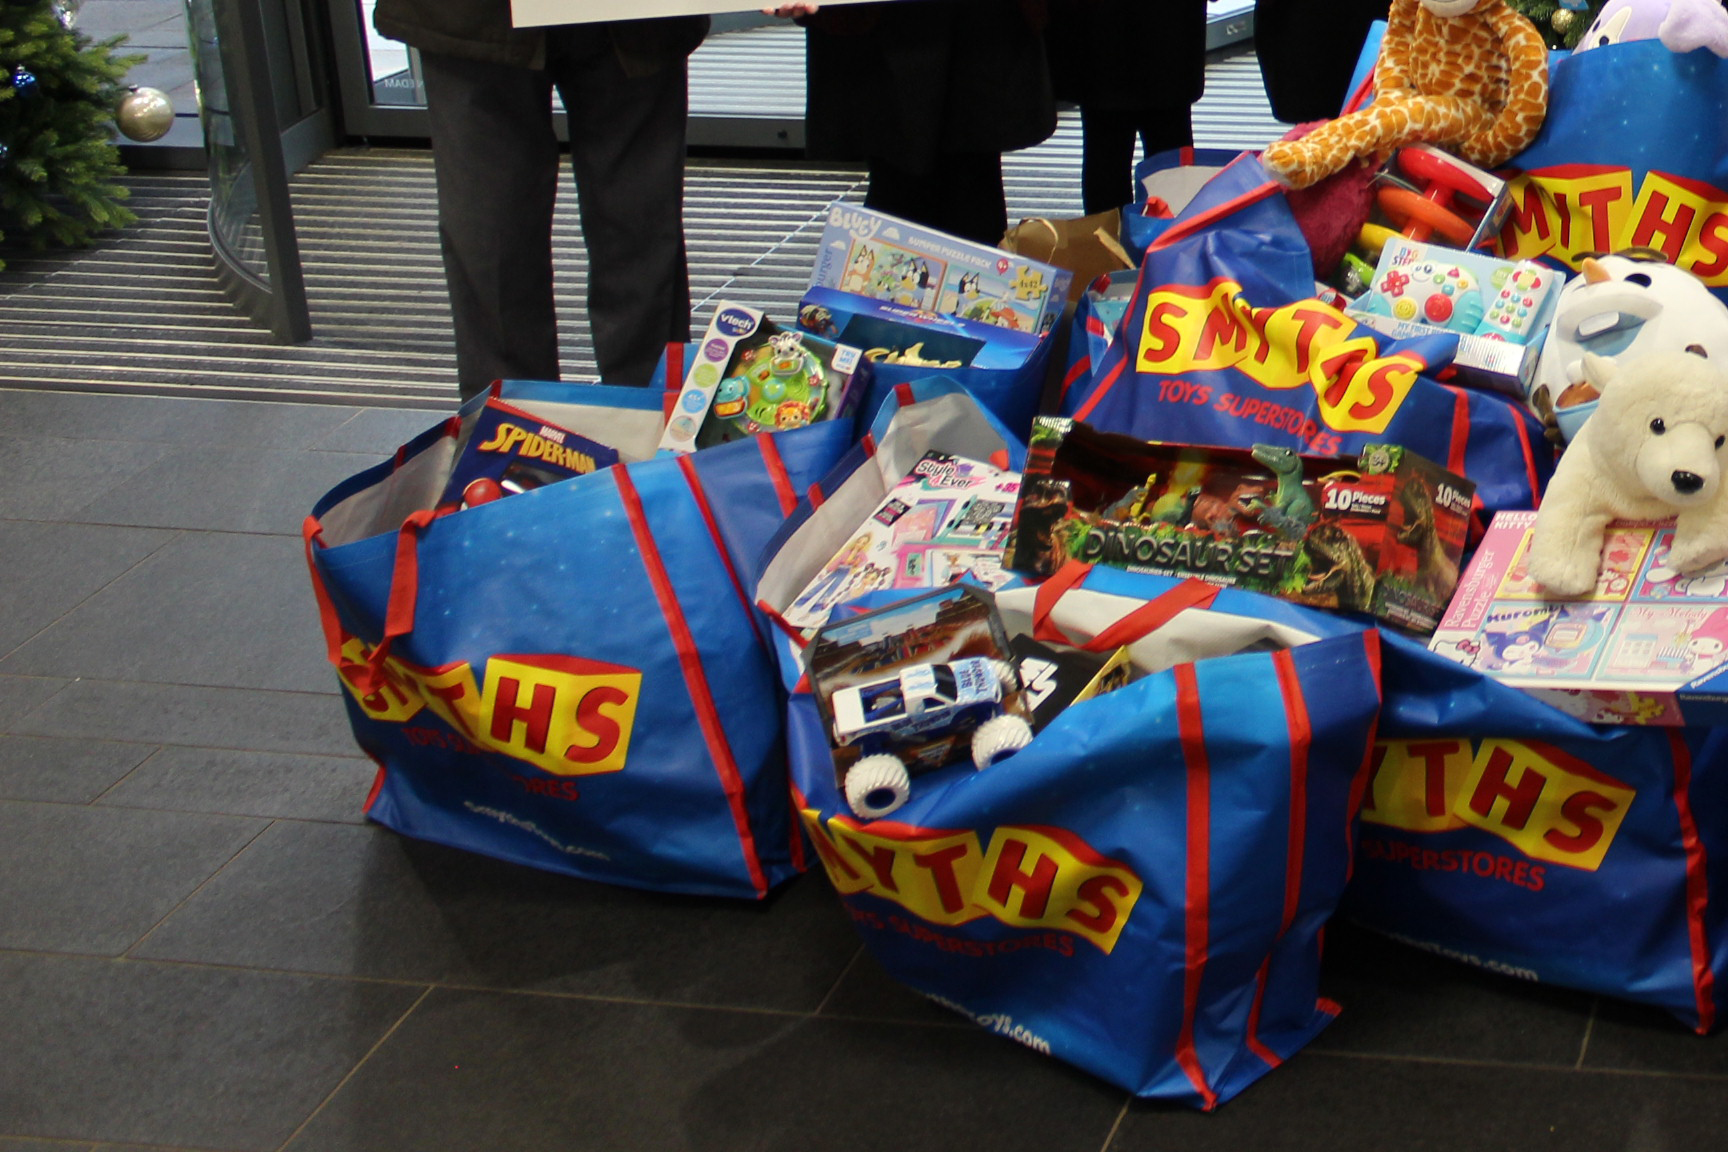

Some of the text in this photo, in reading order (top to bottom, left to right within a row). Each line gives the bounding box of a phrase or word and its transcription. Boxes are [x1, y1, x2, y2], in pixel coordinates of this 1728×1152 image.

[908, 236, 992, 270] BUMPER PUZZLE PACK
[1158, 381, 1345, 457] TOYS SUPERSTORES
[539, 425, 566, 444] MARVEL
[478, 422, 597, 475] SPIDER-MAN
[917, 462, 955, 480] Style
[1325, 488, 1352, 511] 10
[1352, 491, 1386, 506] Pieces
[1435, 483, 1471, 508] 10 Pieces
[1494, 520, 1533, 529] KITTY
[1495, 511, 1537, 522] HELLO
[1086, 530, 1295, 576] DINOSAUR SET
[1445, 549, 1496, 628] Ravensburger
[1461, 590, 1492, 628] Puzzle
[1633, 606, 1707, 619] My Melody
